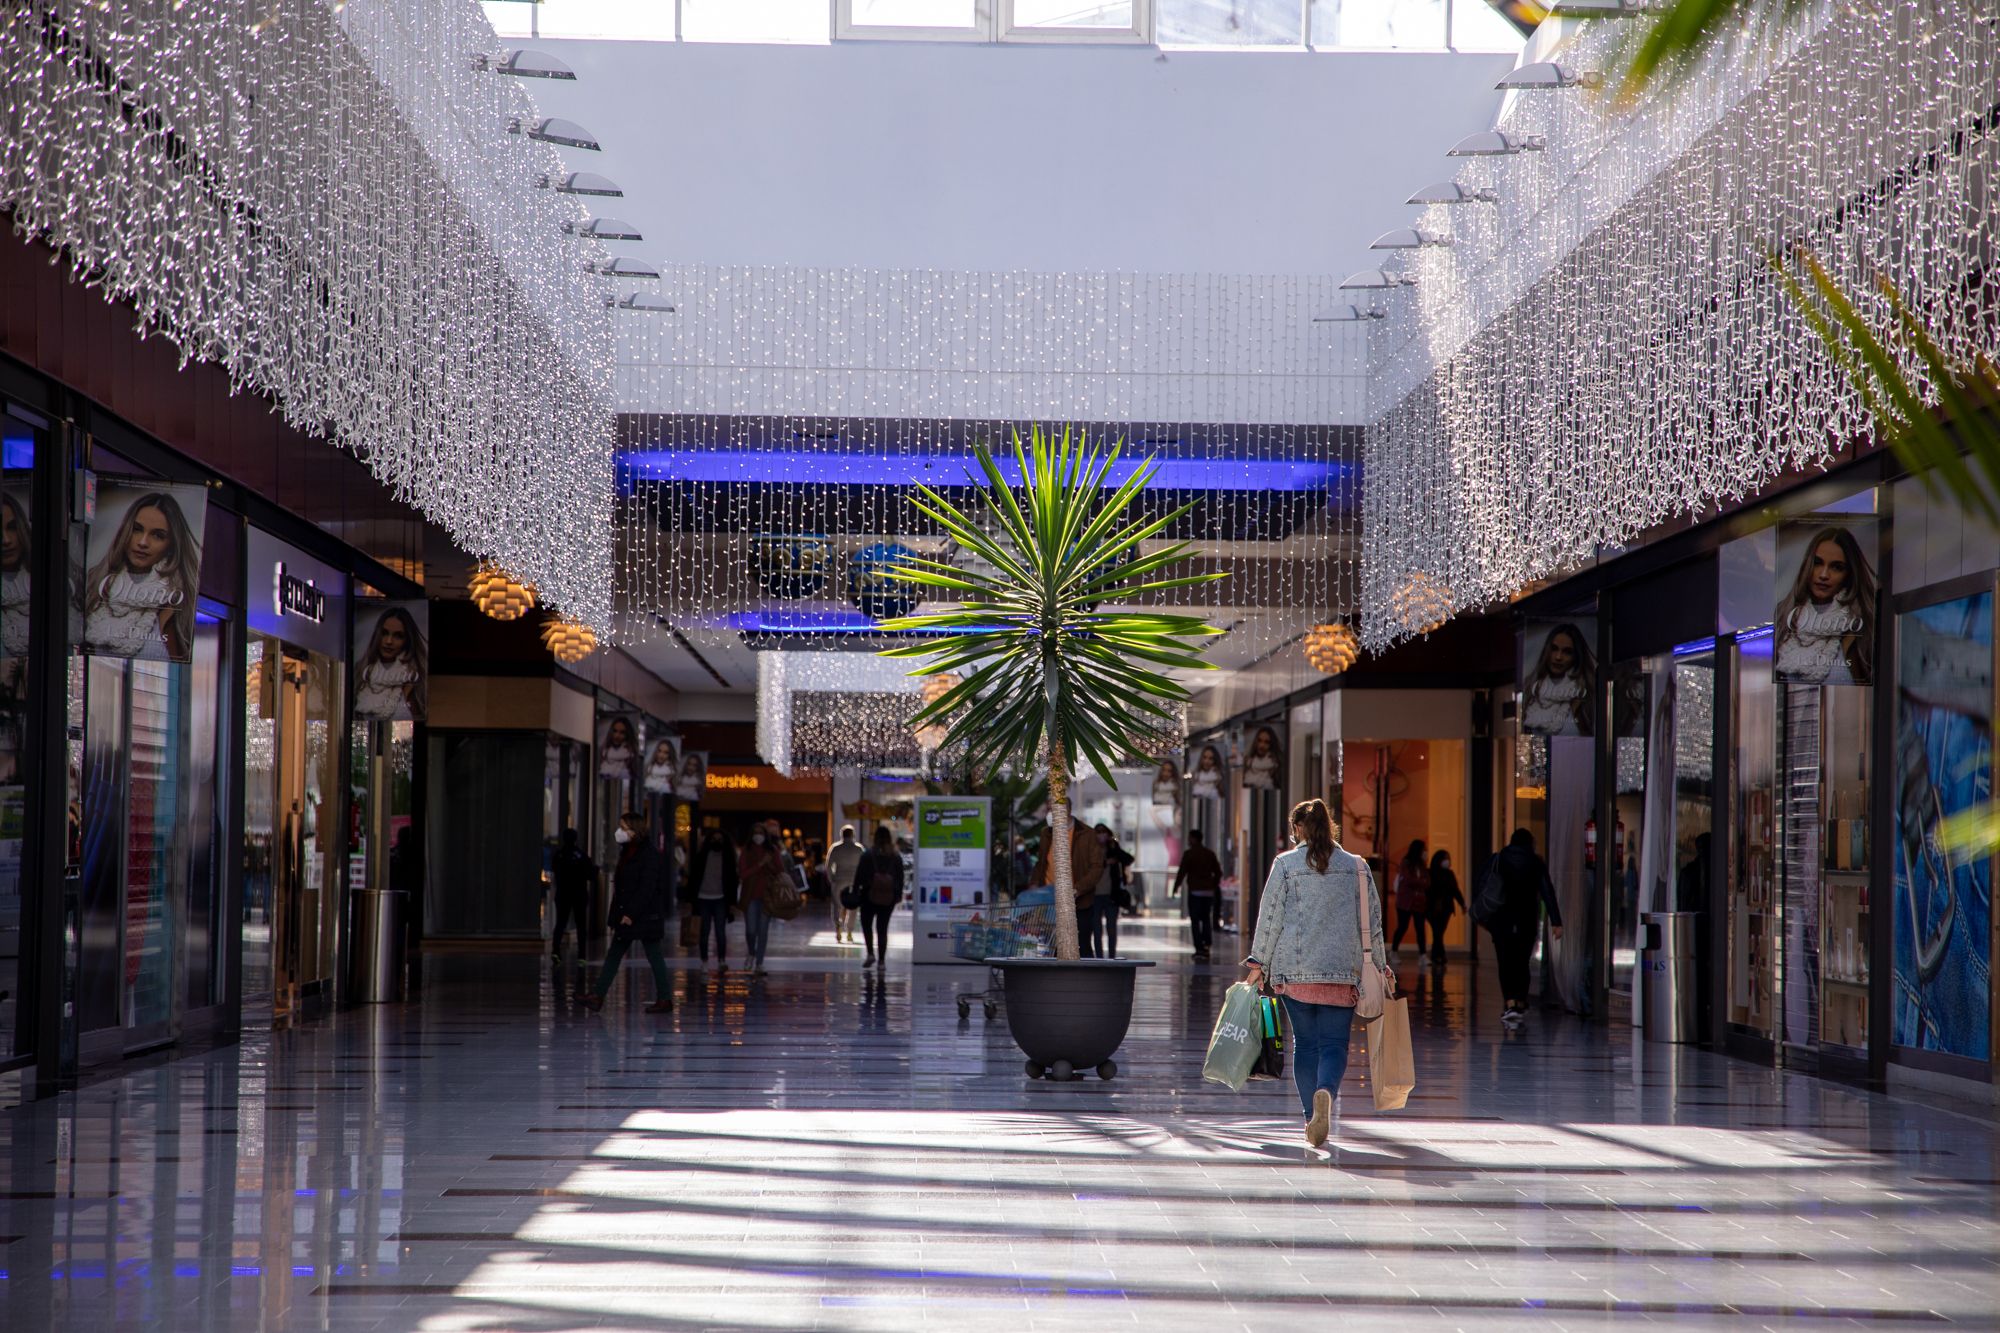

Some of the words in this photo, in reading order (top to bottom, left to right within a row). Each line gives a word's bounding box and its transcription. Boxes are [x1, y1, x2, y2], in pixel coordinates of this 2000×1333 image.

[98, 573, 185, 606] Otoño
[1786, 606, 1864, 633] Otoño
[705, 773, 759, 789] Bershka
